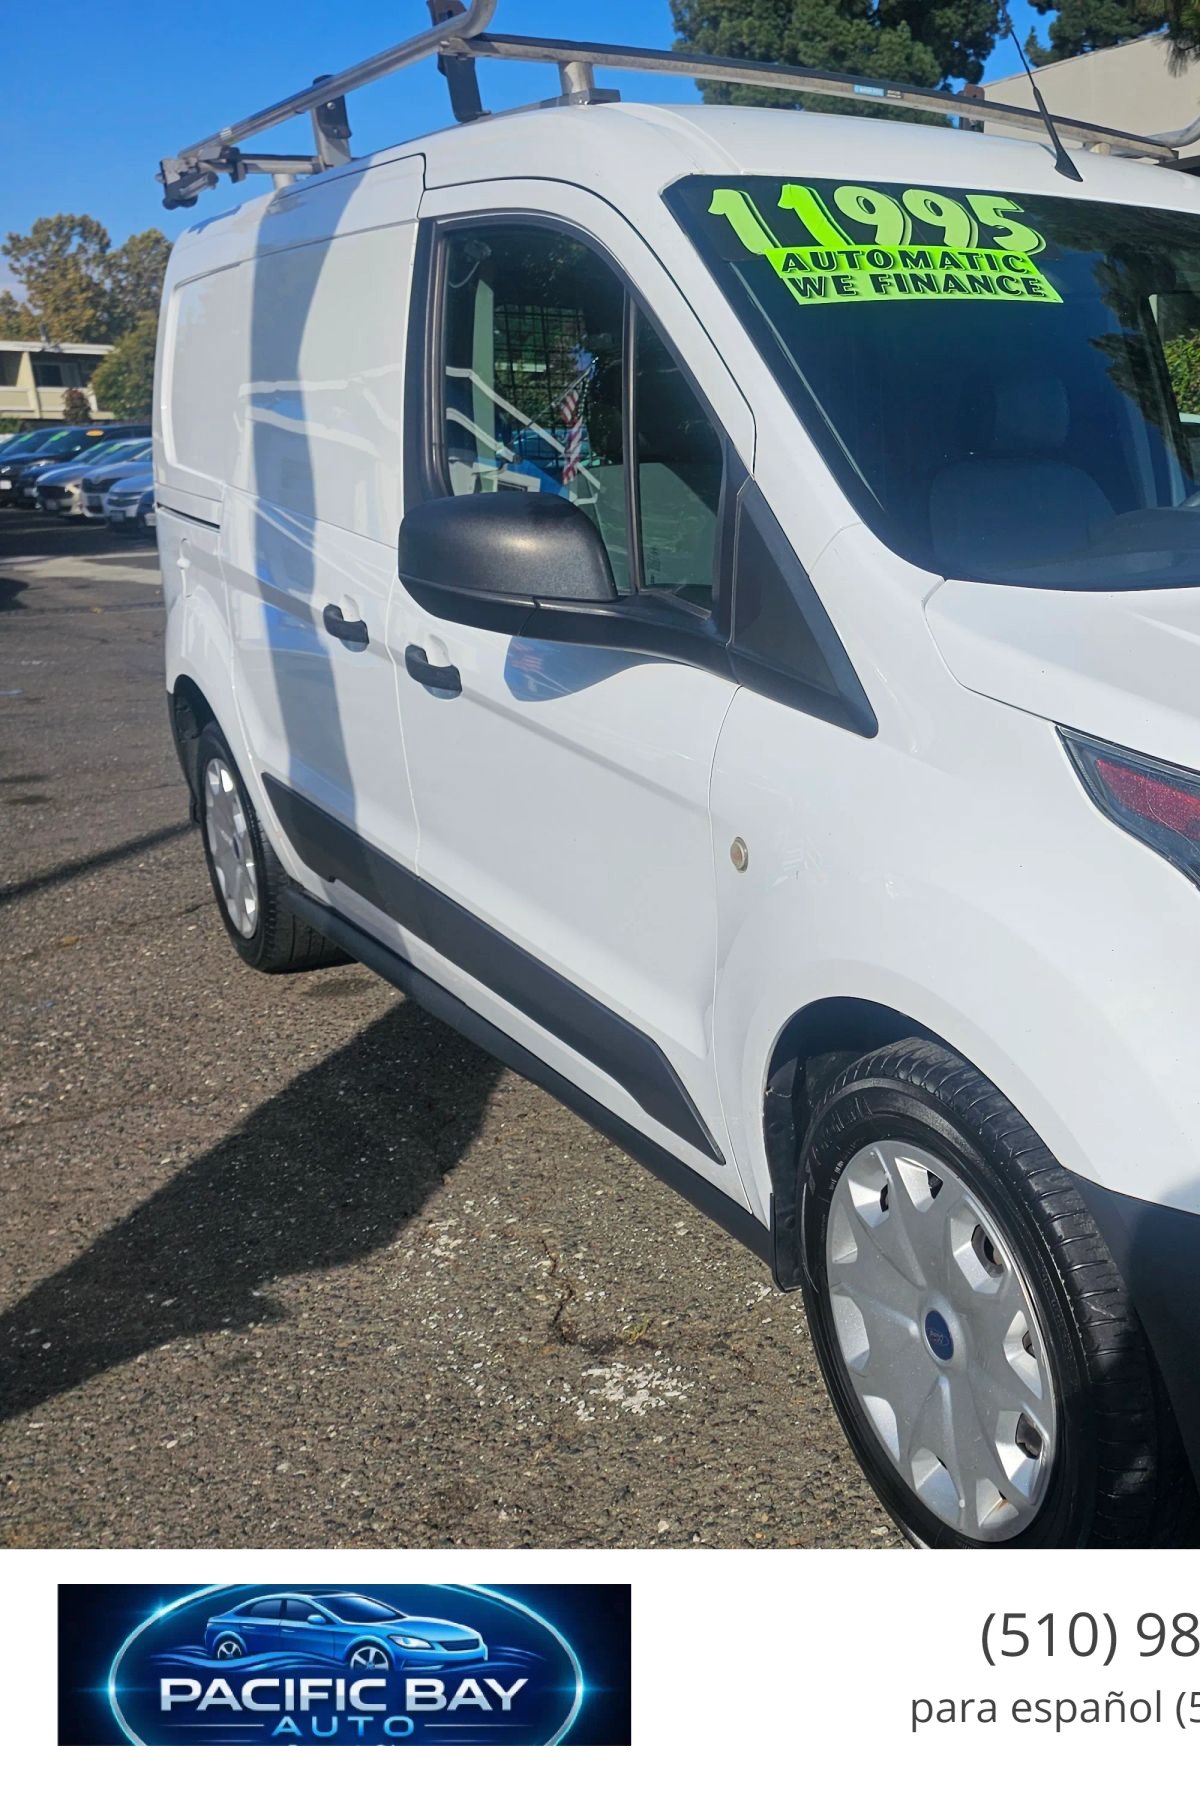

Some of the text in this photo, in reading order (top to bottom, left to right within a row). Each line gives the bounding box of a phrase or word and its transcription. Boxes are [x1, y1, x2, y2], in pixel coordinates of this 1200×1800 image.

[708, 184, 1048, 255] 11995
[781, 248, 1026, 274] AUTOMATIC
[788, 272, 1046, 298] WE FINANCE
